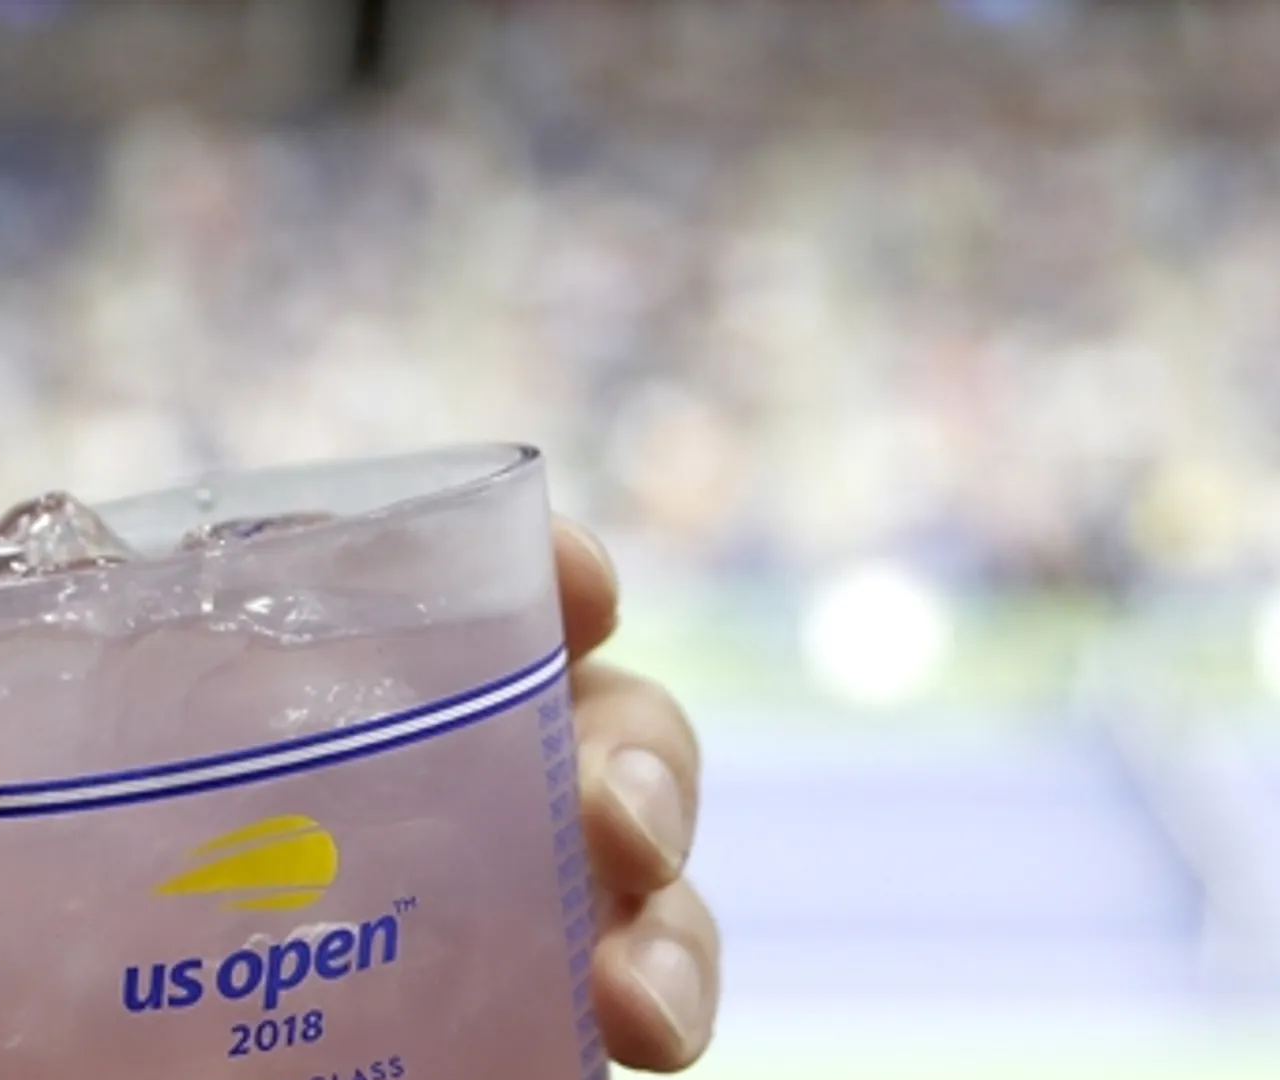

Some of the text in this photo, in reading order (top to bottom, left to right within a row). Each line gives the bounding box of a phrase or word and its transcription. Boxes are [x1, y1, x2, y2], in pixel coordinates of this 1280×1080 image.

[123, 958, 204, 1013] us
[216, 914, 400, 1012] open
[227, 1009, 324, 1058] 2018
